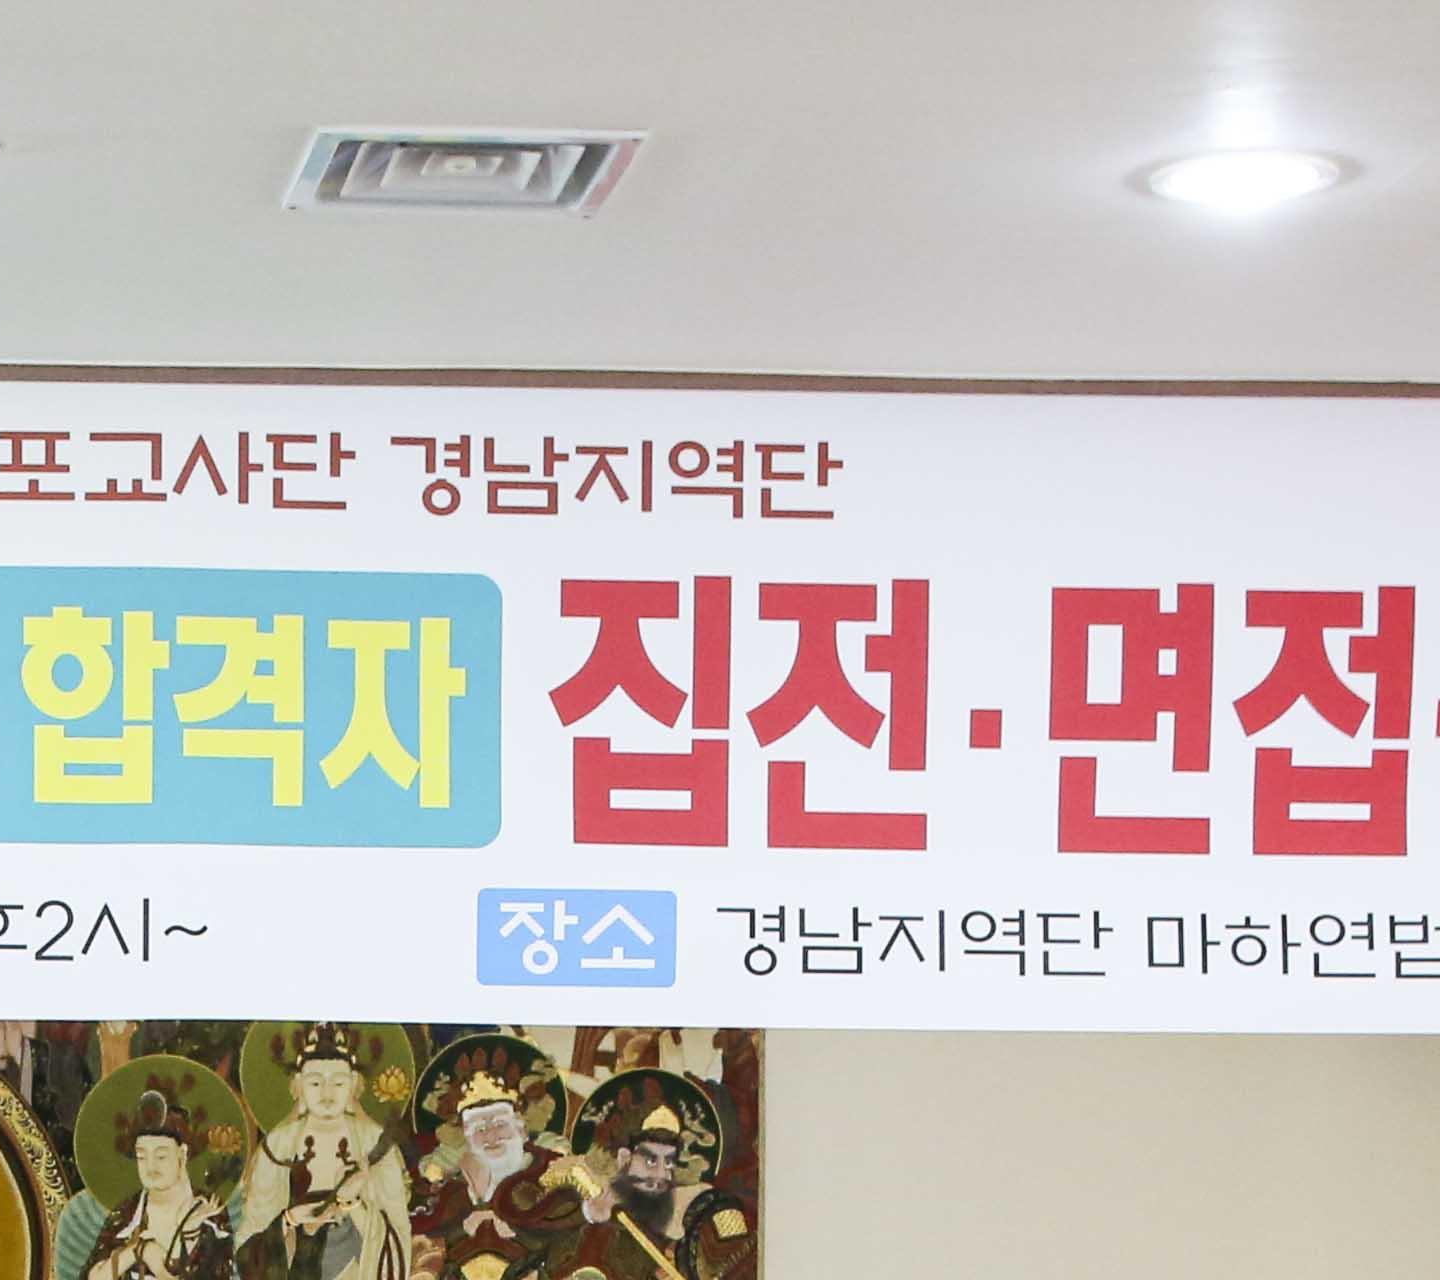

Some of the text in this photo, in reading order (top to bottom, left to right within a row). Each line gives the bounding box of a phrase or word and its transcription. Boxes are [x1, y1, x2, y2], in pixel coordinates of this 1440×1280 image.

[391, 435, 843, 519] 경남지역단
[22, 607, 465, 807] 합격자
[501, 901, 654, 973] 장소
[717, 906, 1113, 976] 경남지역단
